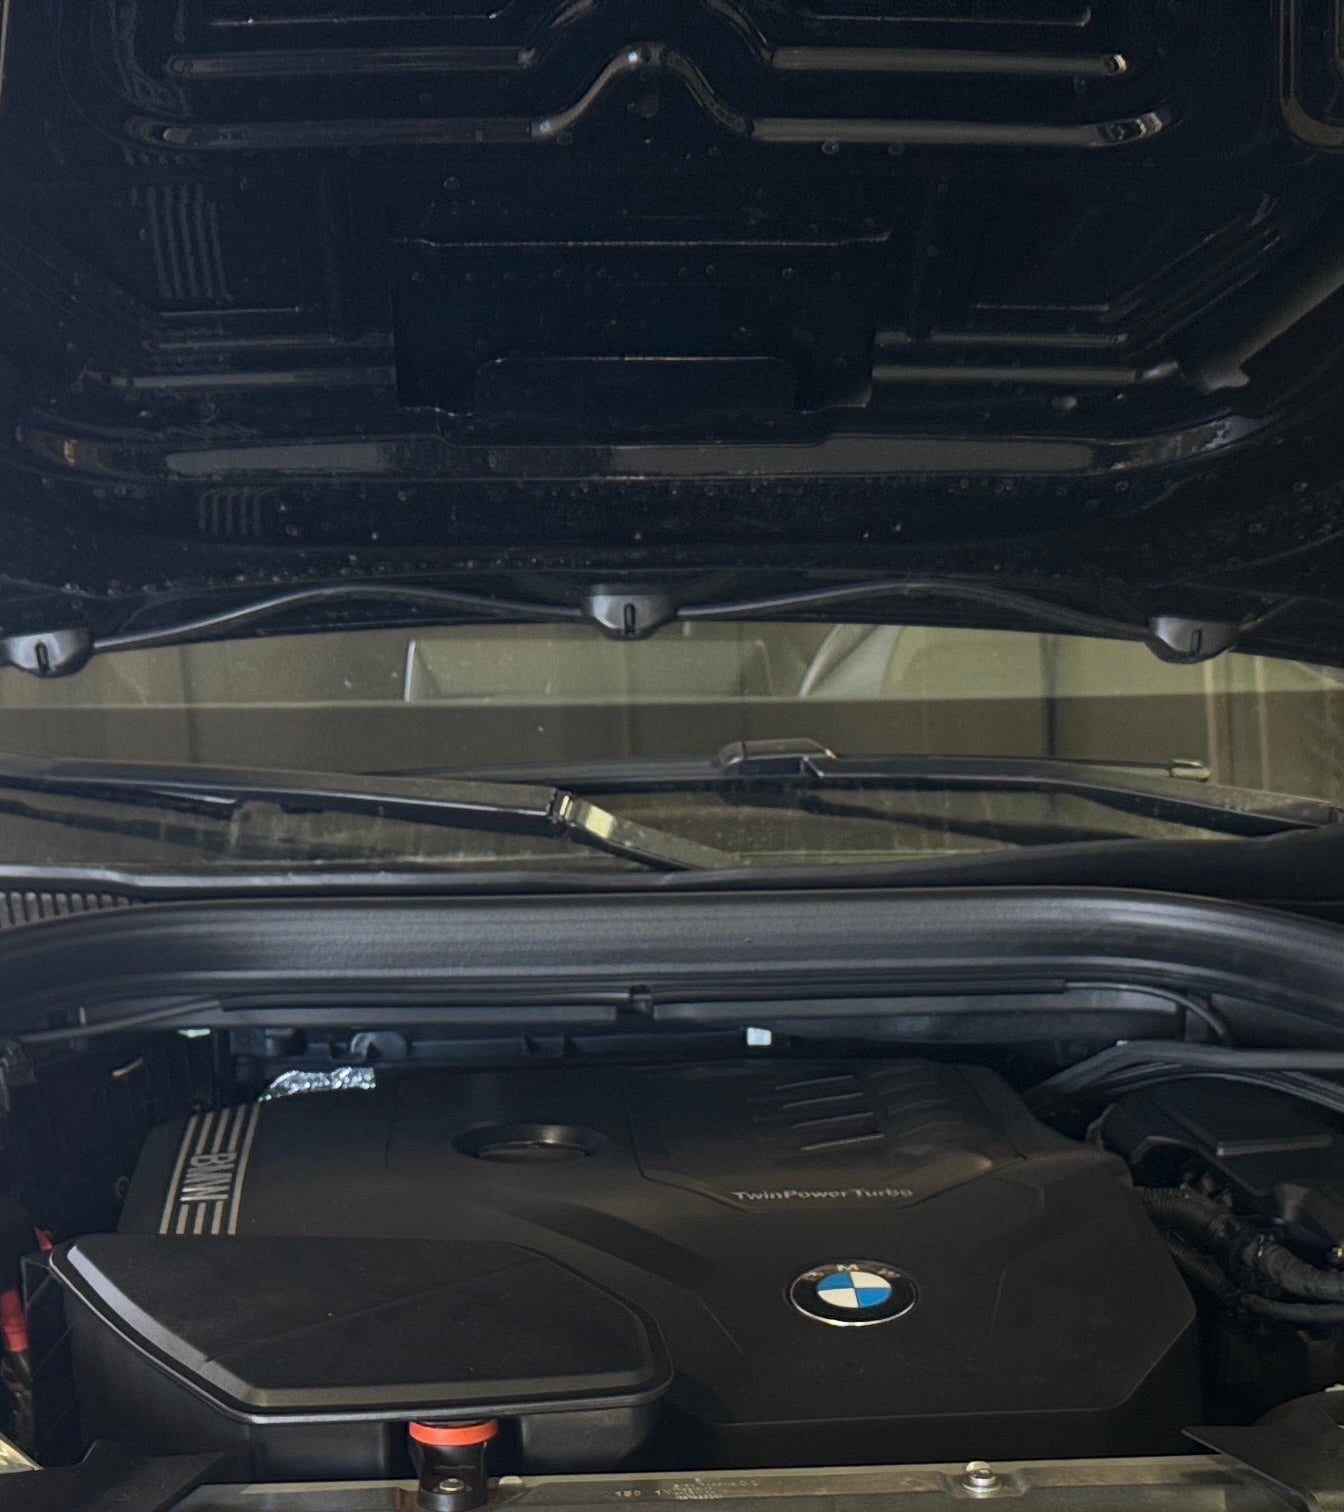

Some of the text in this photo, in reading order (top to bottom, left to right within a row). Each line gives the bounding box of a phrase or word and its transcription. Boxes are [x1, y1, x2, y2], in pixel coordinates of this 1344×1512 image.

[180, 1152, 237, 1201] BMW
[731, 1186, 913, 1200] TwinPower Turbo
